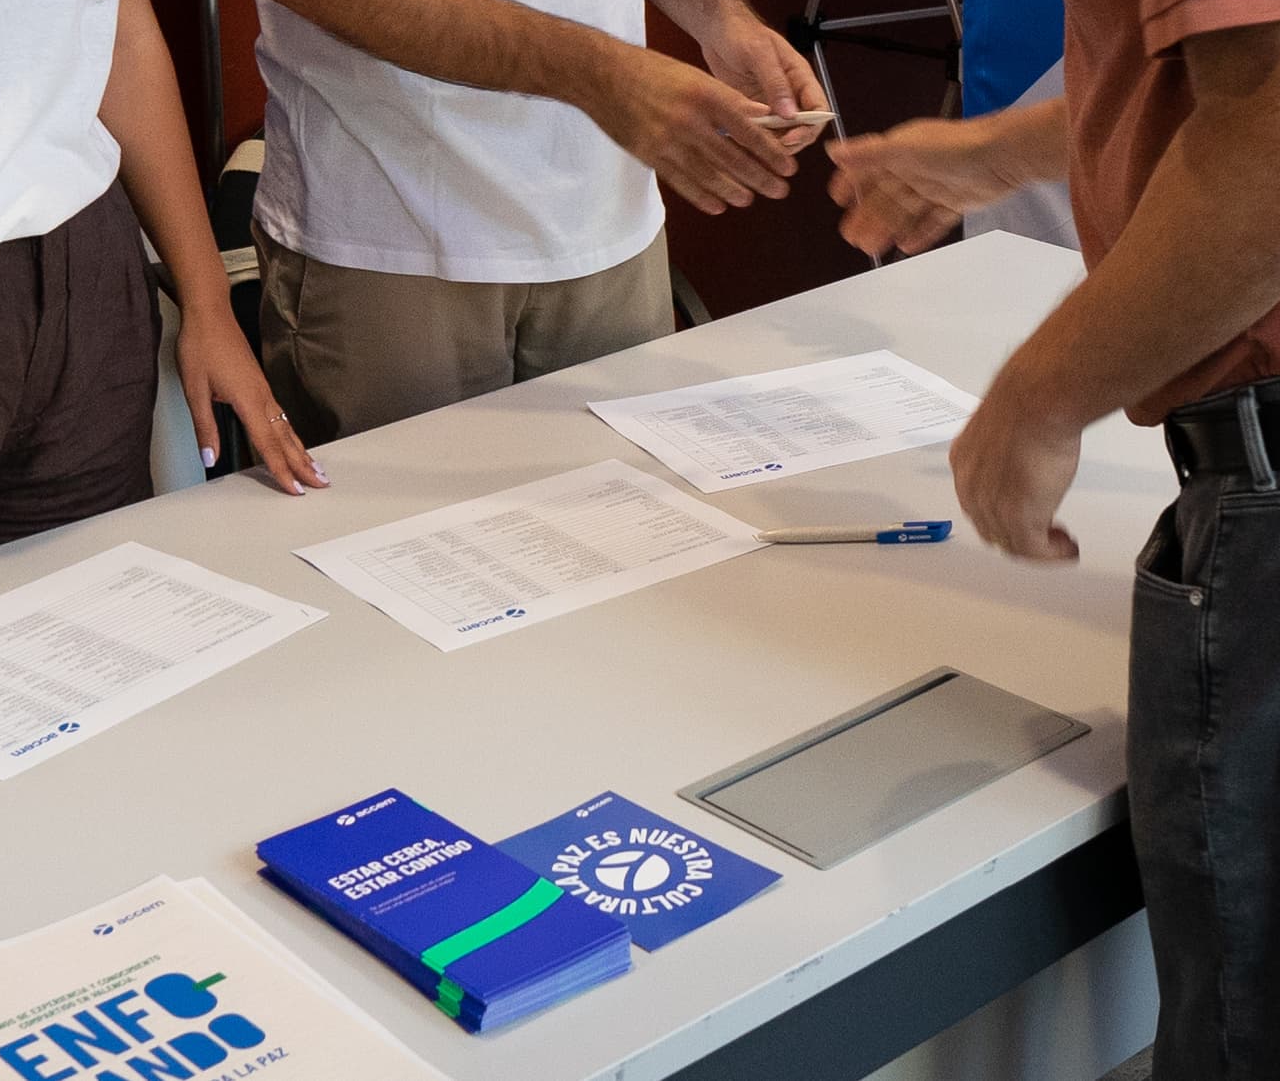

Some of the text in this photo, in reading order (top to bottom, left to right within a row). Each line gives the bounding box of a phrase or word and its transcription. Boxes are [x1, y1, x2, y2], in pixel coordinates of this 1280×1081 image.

[355, 797, 397, 818] accem
[328, 838, 446, 889] ESTAR CERCA,
[344, 871, 403, 900] ESTAR
[399, 840, 473, 876] CONTIGO
[551, 828, 713, 915] LA PAZ ES NUESTRA CULTURA
[257, 1047, 290, 1067] PAZ
